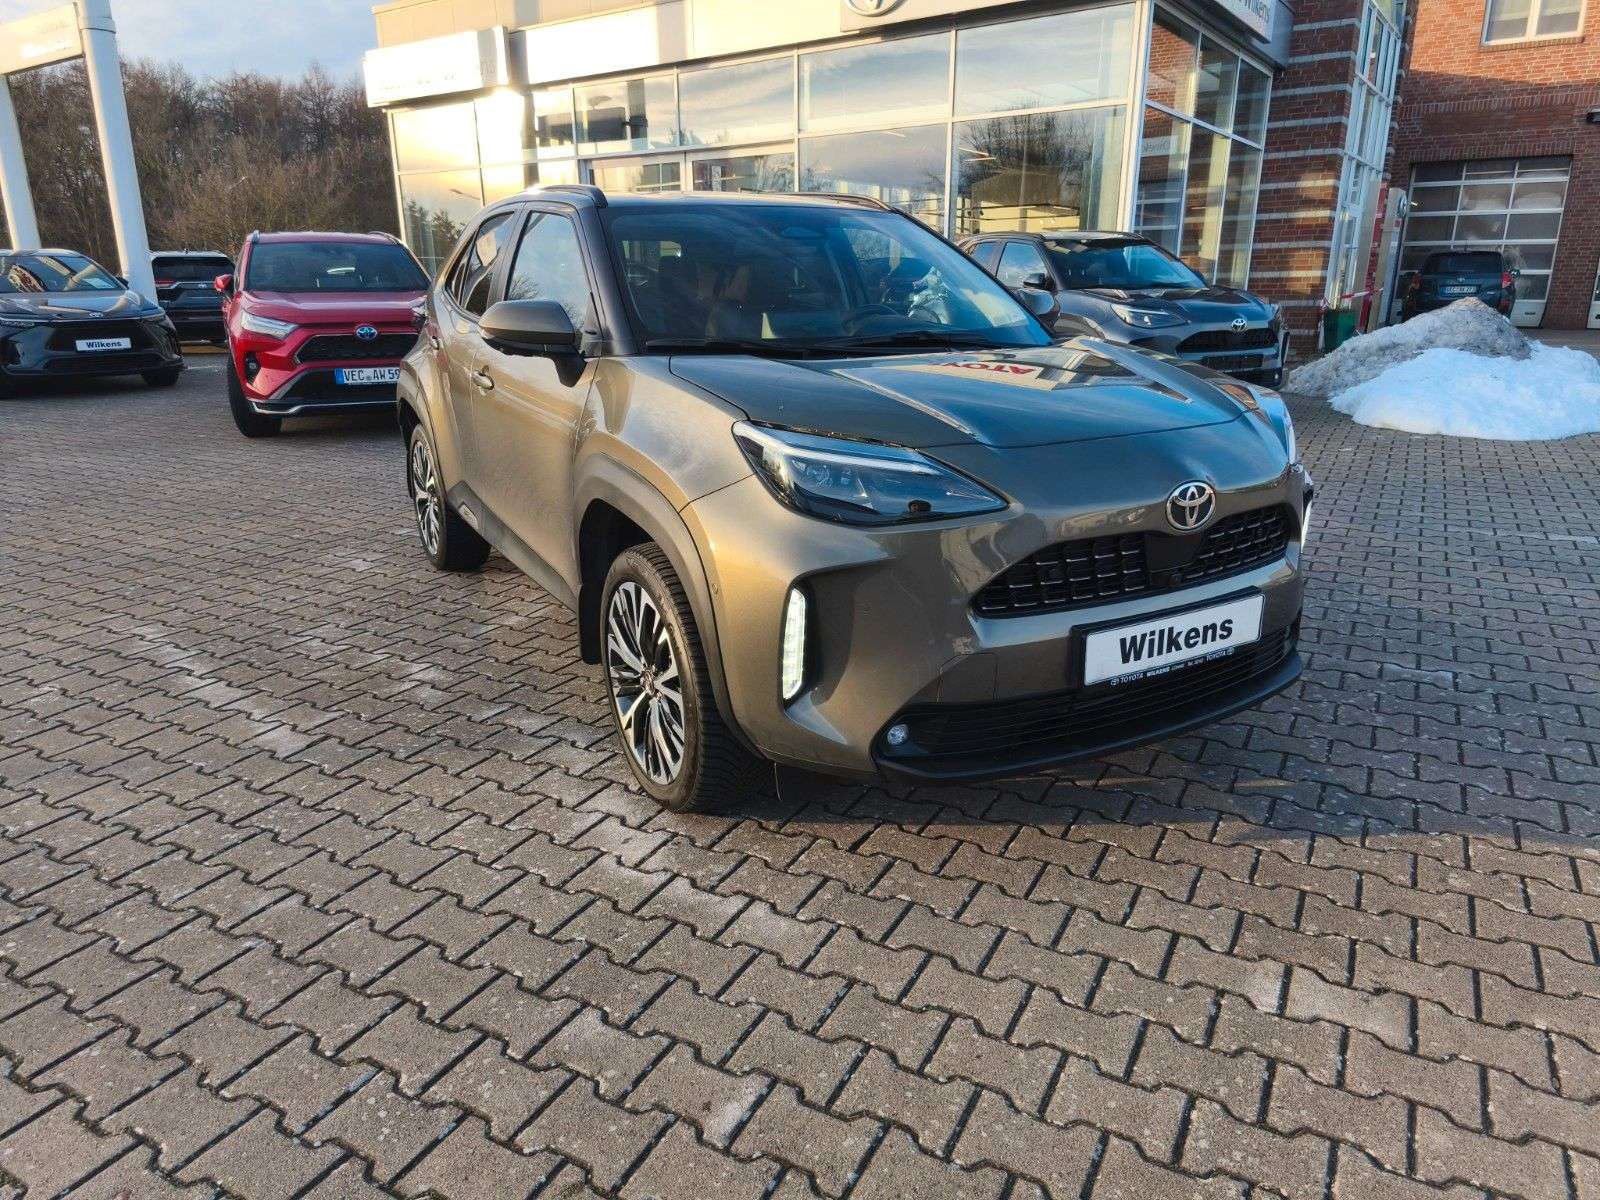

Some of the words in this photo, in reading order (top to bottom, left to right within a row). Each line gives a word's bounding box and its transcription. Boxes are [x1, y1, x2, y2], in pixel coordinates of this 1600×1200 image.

[86, 341, 122, 349] Wilkens
[344, 369, 365, 381] VEC
[373, 369, 386, 380] AW
[1119, 618, 1234, 665] Wilkens
